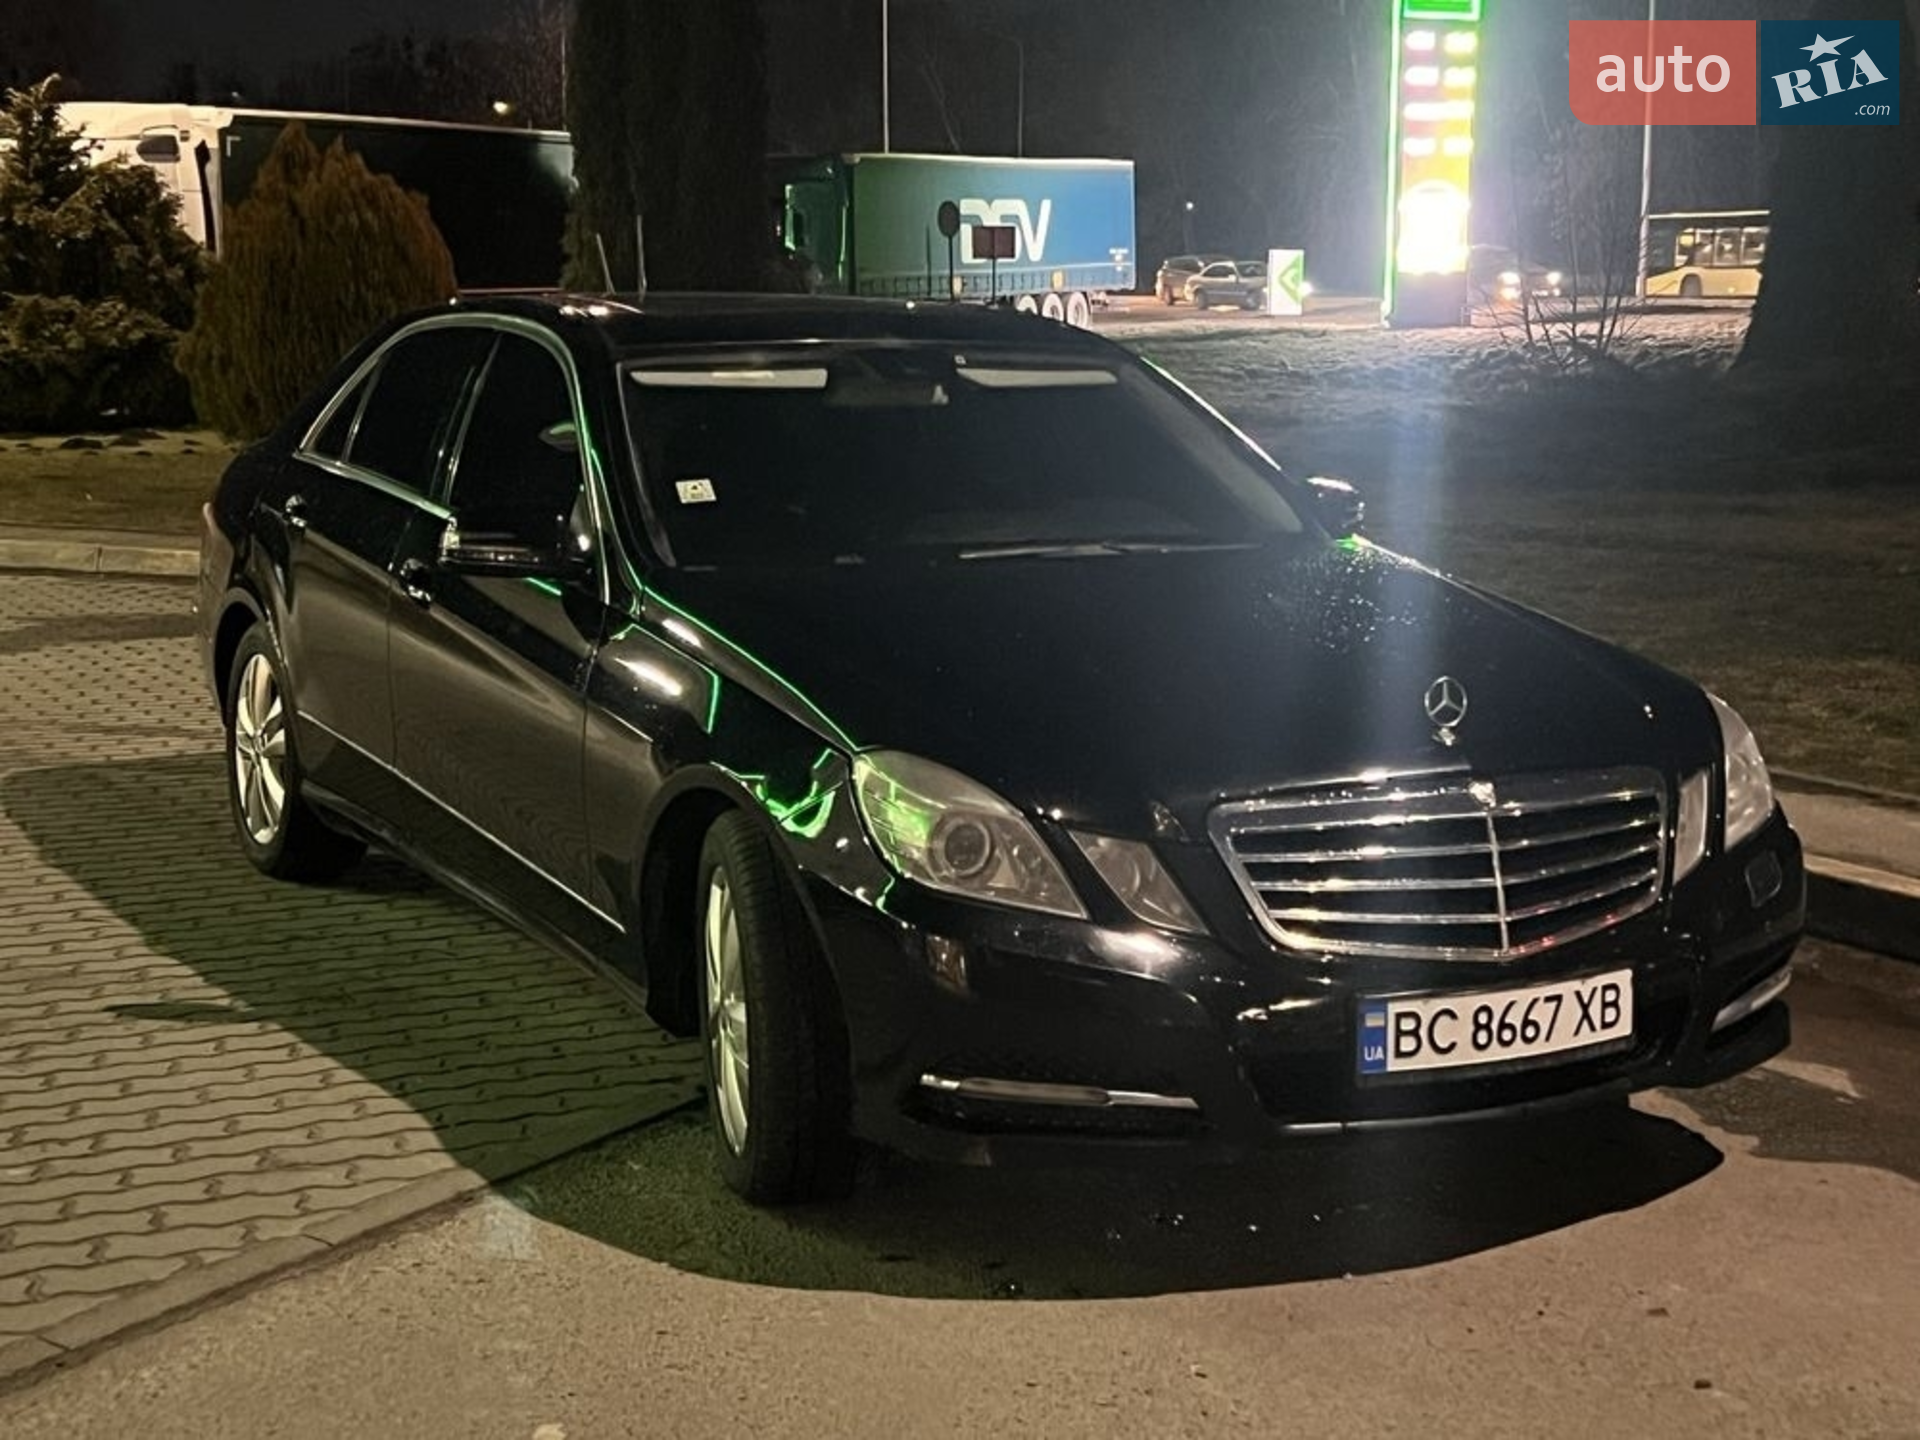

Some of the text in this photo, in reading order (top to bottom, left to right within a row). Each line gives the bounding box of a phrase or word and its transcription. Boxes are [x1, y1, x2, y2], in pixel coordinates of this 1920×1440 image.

[1393, 983, 1621, 1059] BC 8667 XB
[1364, 1046, 1385, 1061] UA
